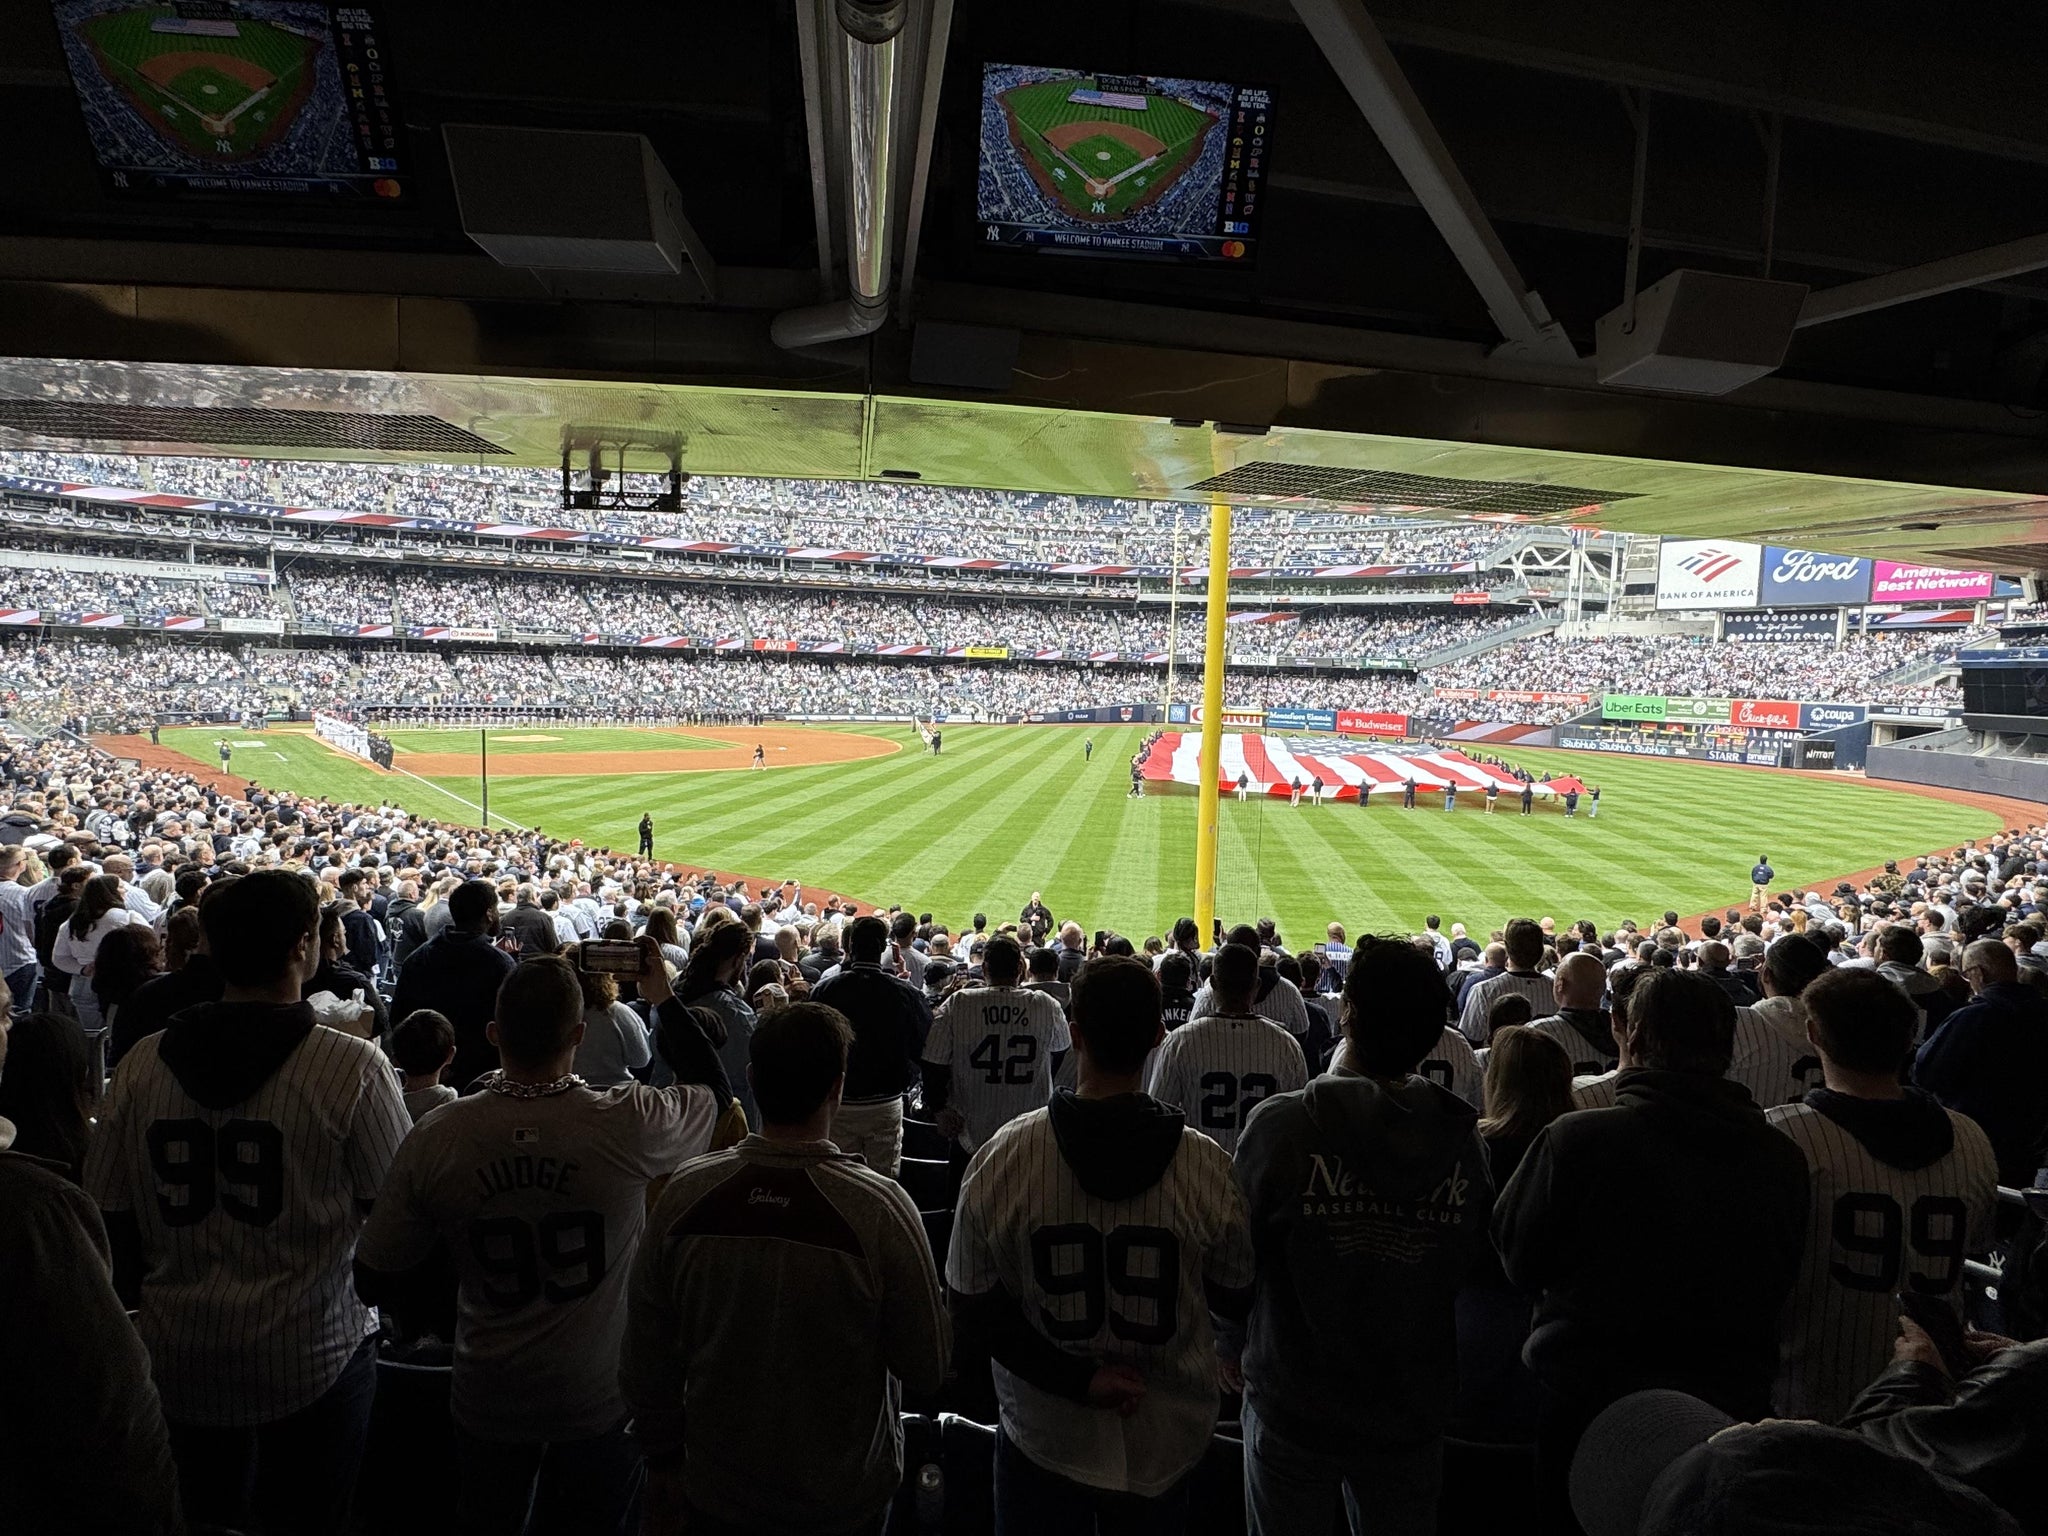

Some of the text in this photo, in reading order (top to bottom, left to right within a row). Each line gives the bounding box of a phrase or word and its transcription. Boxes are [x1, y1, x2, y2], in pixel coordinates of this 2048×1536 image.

[1054, 233, 1164, 250] WELCOME TO YANKEE STADIUM
[1772, 550, 1860, 583] Ford
[1876, 575, 1990, 592] Best Network
[1660, 592, 1688, 600] BANK
[1706, 589, 1754, 598] AMERICA
[764, 641, 788, 650] AVIS
[1240, 656, 1269, 664] ORIS
[1192, 707, 1260, 723] Cnon
[1606, 702, 1633, 712] Uber
[1636, 704, 1662, 714] Eats
[1824, 710, 1854, 722] coupa
[1355, 719, 1403, 731] Budweiser
[1562, 739, 1597, 749] StubHub
[1599, 742, 1632, 753] StubHub
[1634, 745, 1667, 755] StubHub
[1709, 750, 1739, 761] STARR
[982, 1006, 1029, 1027] 100%
[970, 1034, 1037, 1084] 42
[145, 1118, 284, 1227] 99
[476, 1156, 581, 1200] JUDGE
[1303, 1200, 1462, 1225] BASEBALL CLUB
[1830, 1192, 1967, 1294] 99
[470, 1209, 606, 1308] 99
[1031, 1222, 1180, 1345] 99
